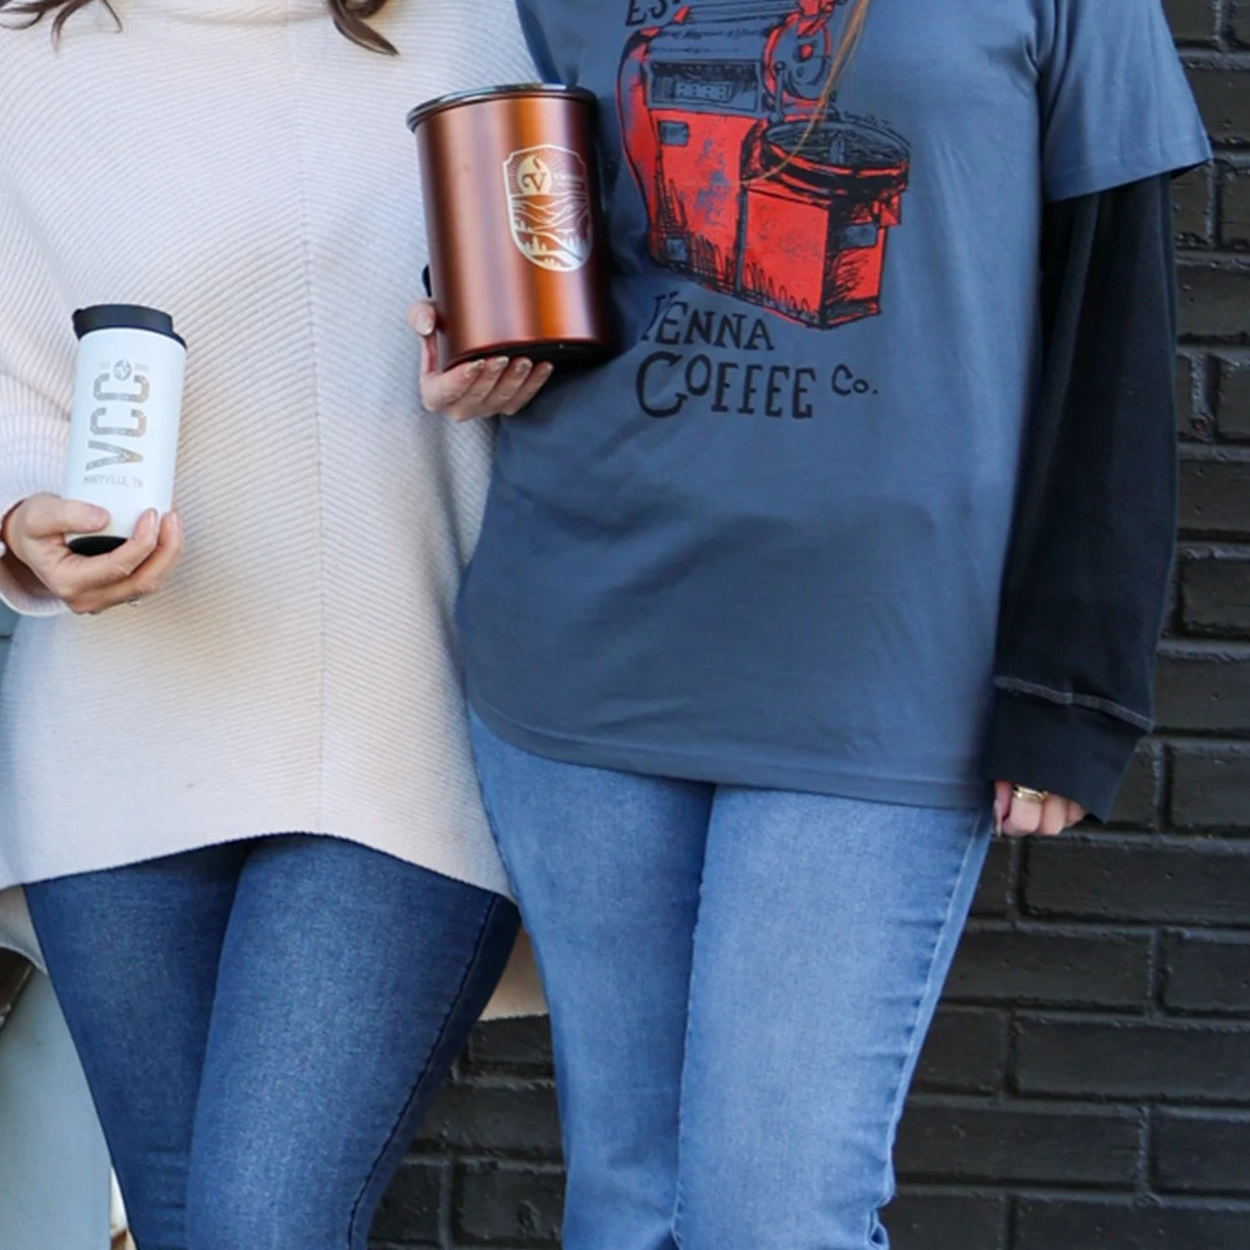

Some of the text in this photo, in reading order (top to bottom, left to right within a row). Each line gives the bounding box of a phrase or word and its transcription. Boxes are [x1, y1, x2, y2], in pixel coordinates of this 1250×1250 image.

[640, 291, 774, 350] ENNA
[636, 351, 816, 419] COFFEE
[85, 373, 150, 471] VCC
